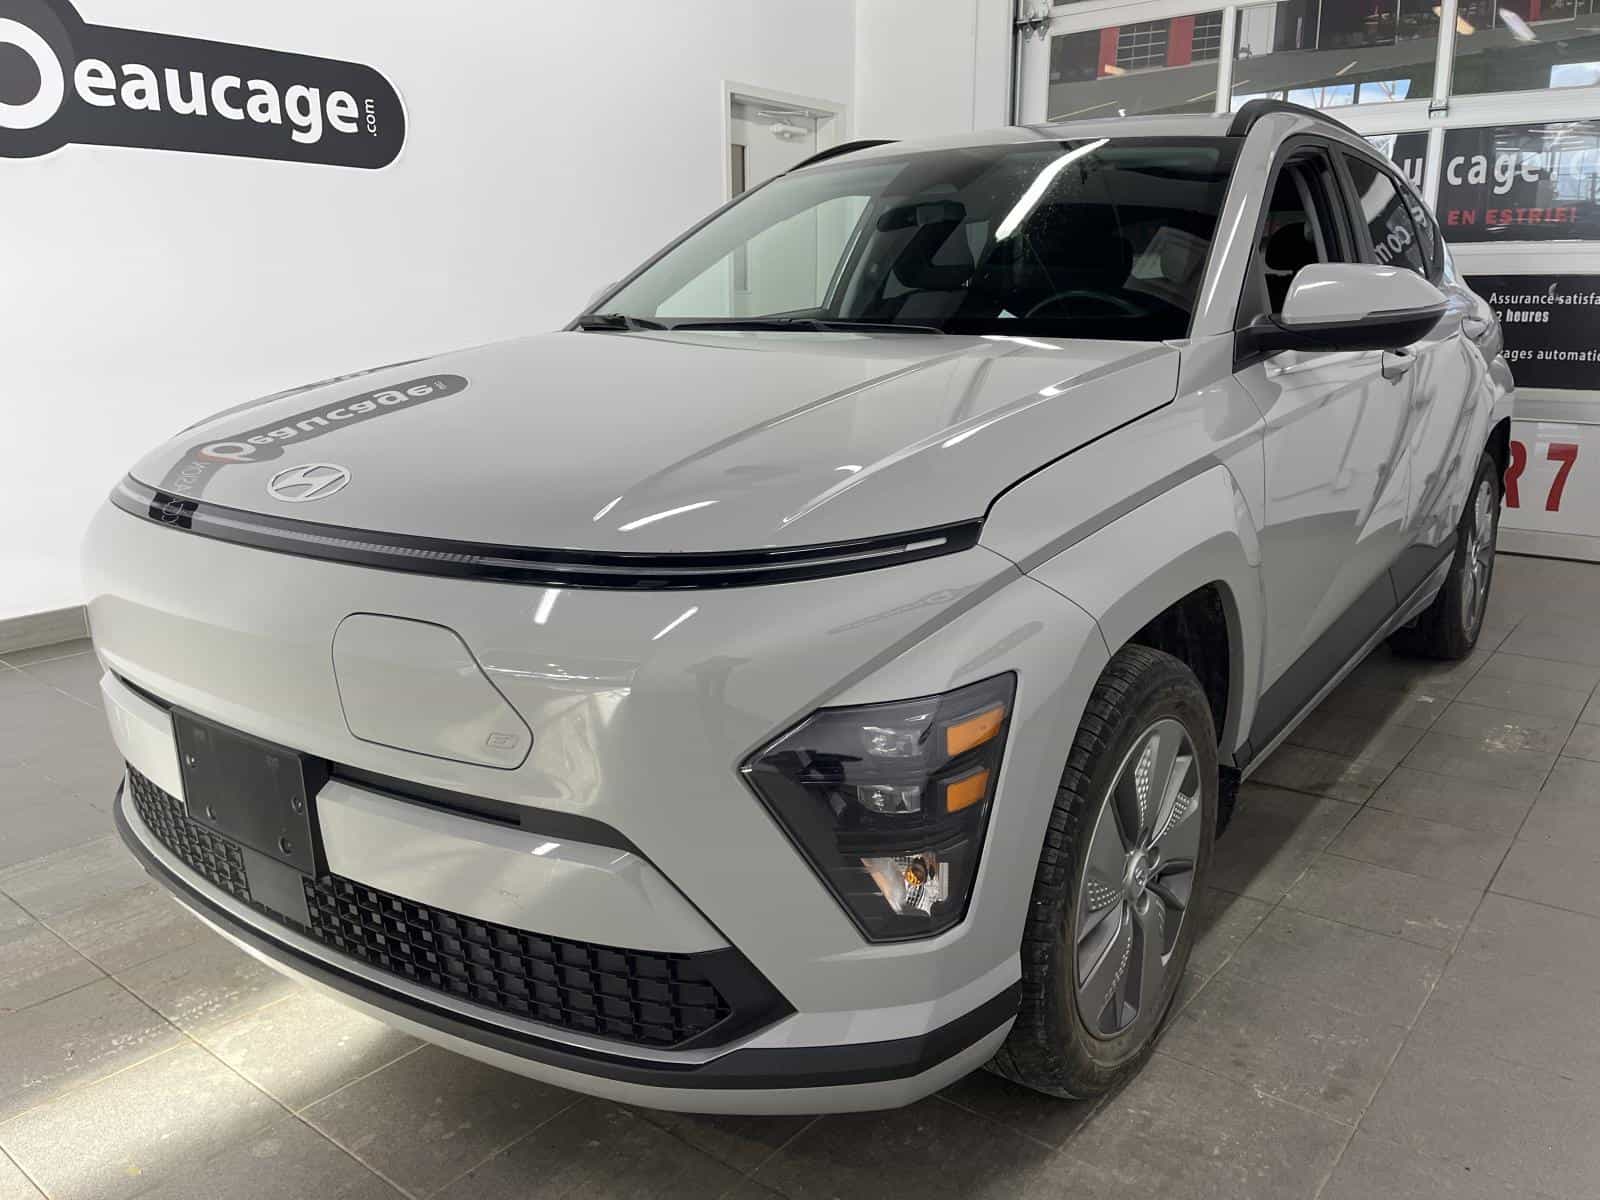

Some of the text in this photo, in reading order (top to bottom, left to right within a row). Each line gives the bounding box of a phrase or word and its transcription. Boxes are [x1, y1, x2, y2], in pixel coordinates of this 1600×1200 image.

[0, 18, 359, 144] eaucage
[365, 99, 377, 136] .com
[1447, 209, 1475, 225] EN
[1489, 292, 1554, 305] Assurance
[1505, 308, 1550, 323] heures
[1501, 349, 1533, 362] ages
[1545, 443, 1579, 512] 7
